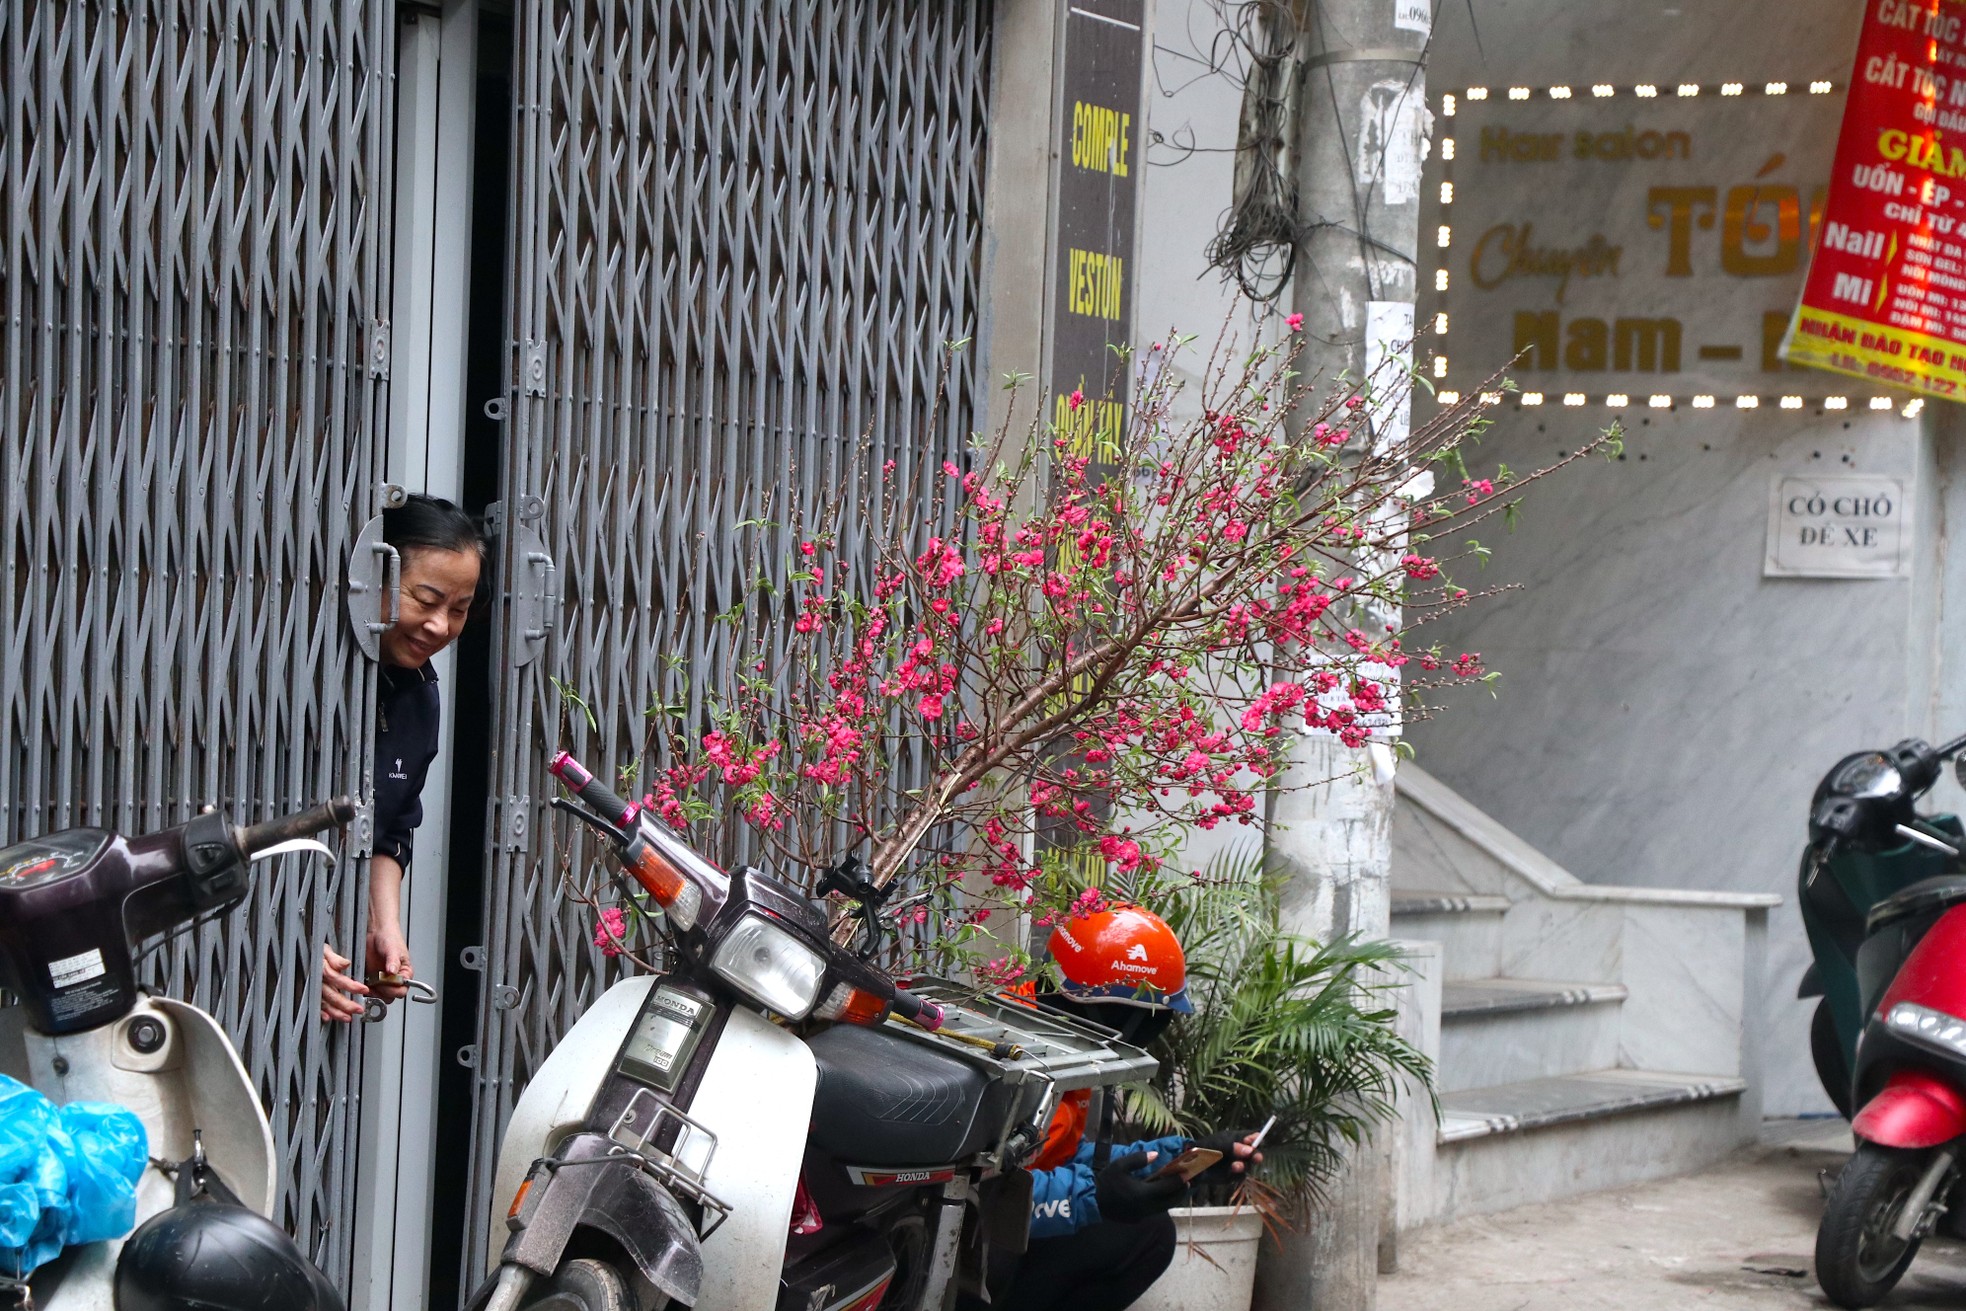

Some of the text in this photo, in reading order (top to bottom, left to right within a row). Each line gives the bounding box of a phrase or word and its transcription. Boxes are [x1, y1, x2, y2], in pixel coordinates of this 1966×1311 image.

[1072, 101, 1130, 177] COMPLE
[1573, 122, 1692, 161] salon
[1647, 152, 1829, 277] TÓ
[1824, 220, 1886, 260] Nail
[1069, 248, 1122, 320] VESTON
[1832, 272, 1873, 306] Mi
[1513, 310, 1682, 373] Nam
[1789, 491, 1826, 517] CÓ
[1844, 526, 1878, 547] XE
[1111, 960, 1158, 975] Ahamove
[656, 995, 695, 1015] HONDA
[896, 1172, 930, 1183] HONDA
